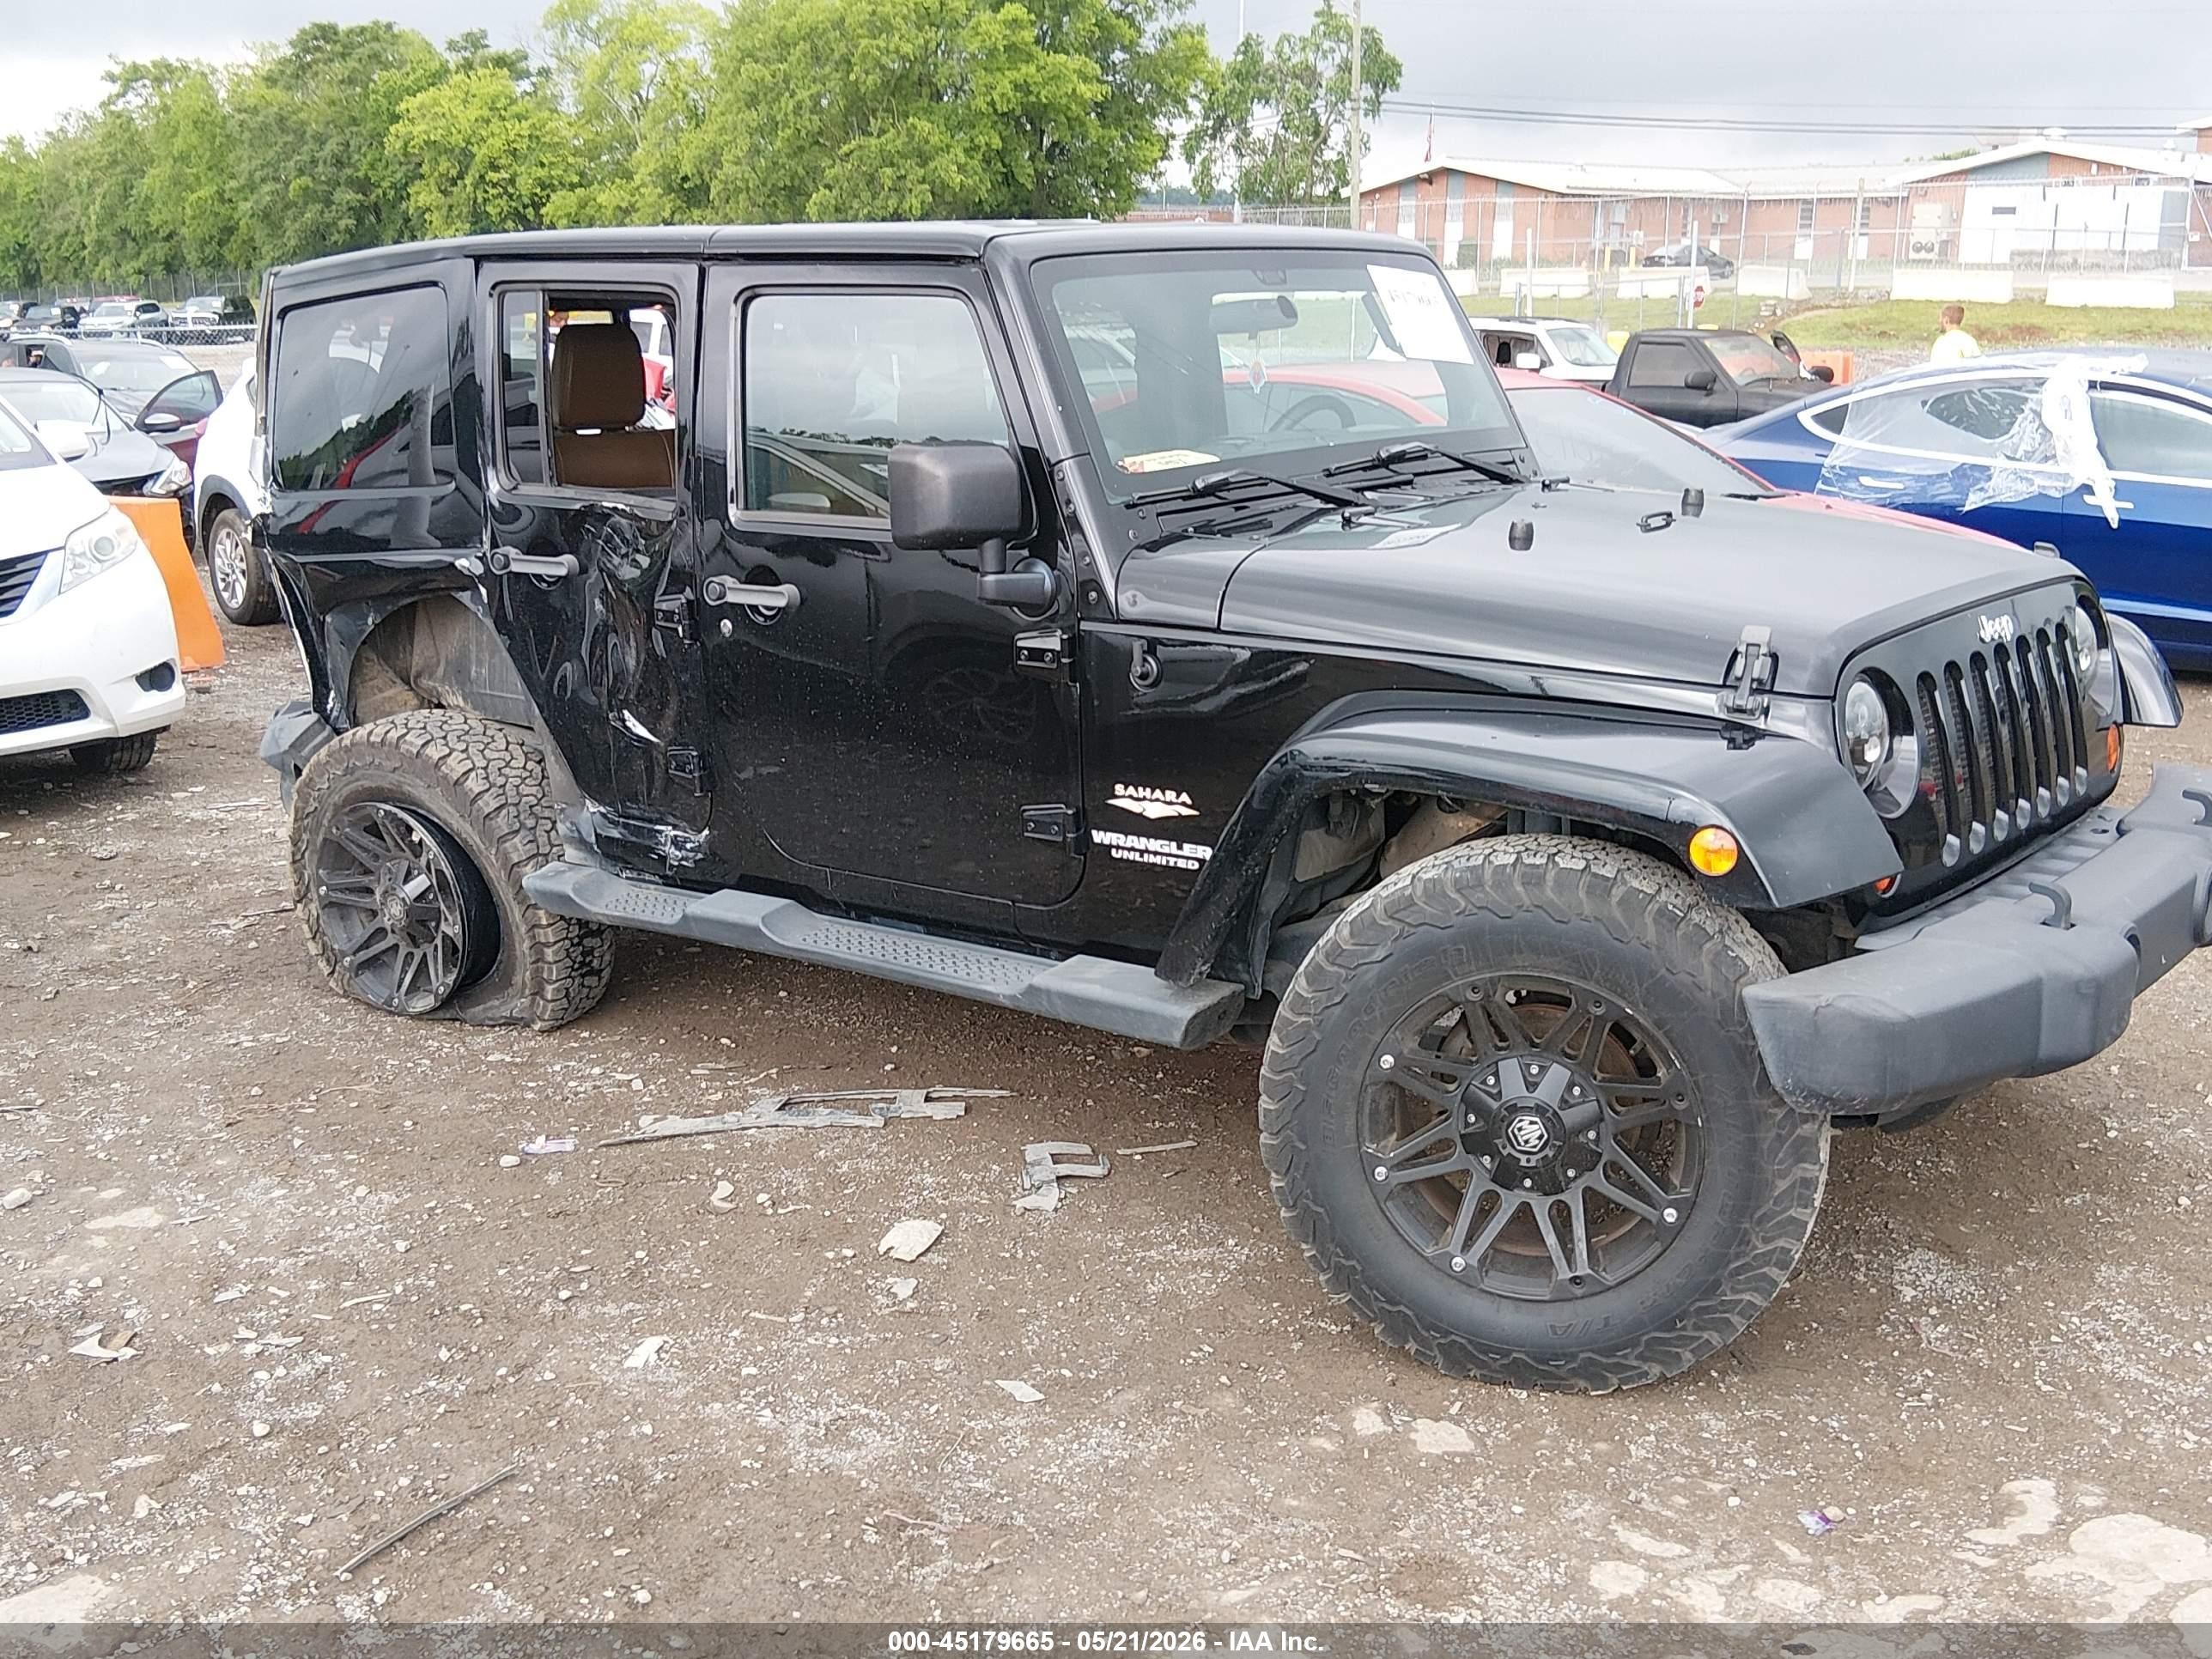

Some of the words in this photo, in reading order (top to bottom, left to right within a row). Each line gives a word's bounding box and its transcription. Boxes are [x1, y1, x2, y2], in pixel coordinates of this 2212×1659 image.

[1977, 615, 2014, 642] Jeep
[1114, 783, 1194, 805] SAHARA
[1091, 829, 1213, 861] WRANGLER
[1110, 848, 1200, 871] UNLIMITED
